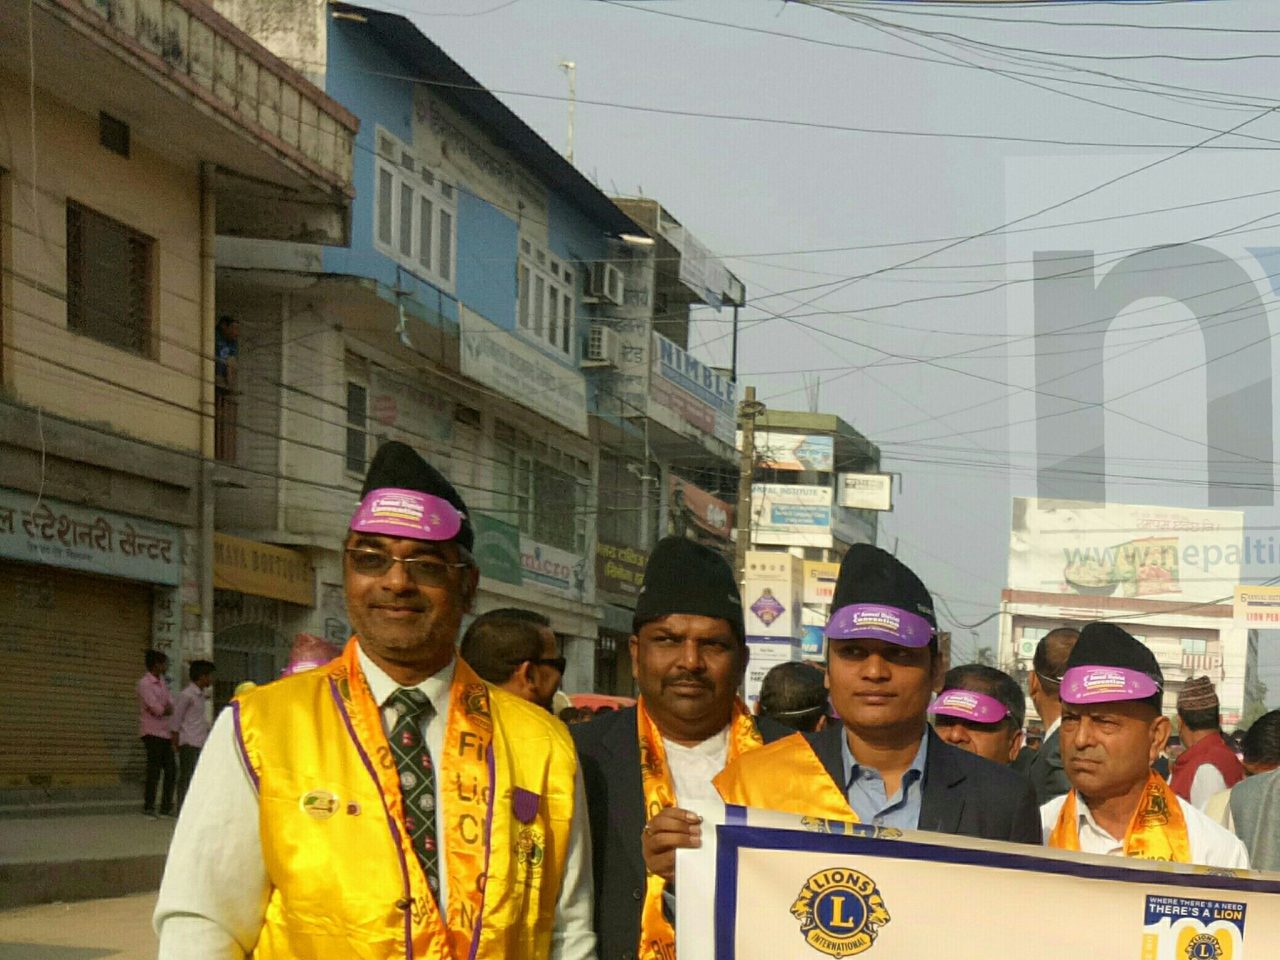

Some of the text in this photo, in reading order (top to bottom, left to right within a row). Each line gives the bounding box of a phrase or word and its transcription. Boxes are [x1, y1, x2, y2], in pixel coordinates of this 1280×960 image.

[659, 336, 735, 401] NIMBLE
[20, 504, 113, 552] स्टेशनरी
[119, 522, 173, 565] सेन्टर
[520, 552, 571, 578] micro
[1247, 613, 1263, 622] LION
[814, 871, 871, 892] LIONS
[1149, 896, 1178, 905] WHERE
[830, 896, 854, 928] L
[1149, 903, 1242, 920] THERE'S A LION
[811, 933, 868, 952] INTERNATIONAL
